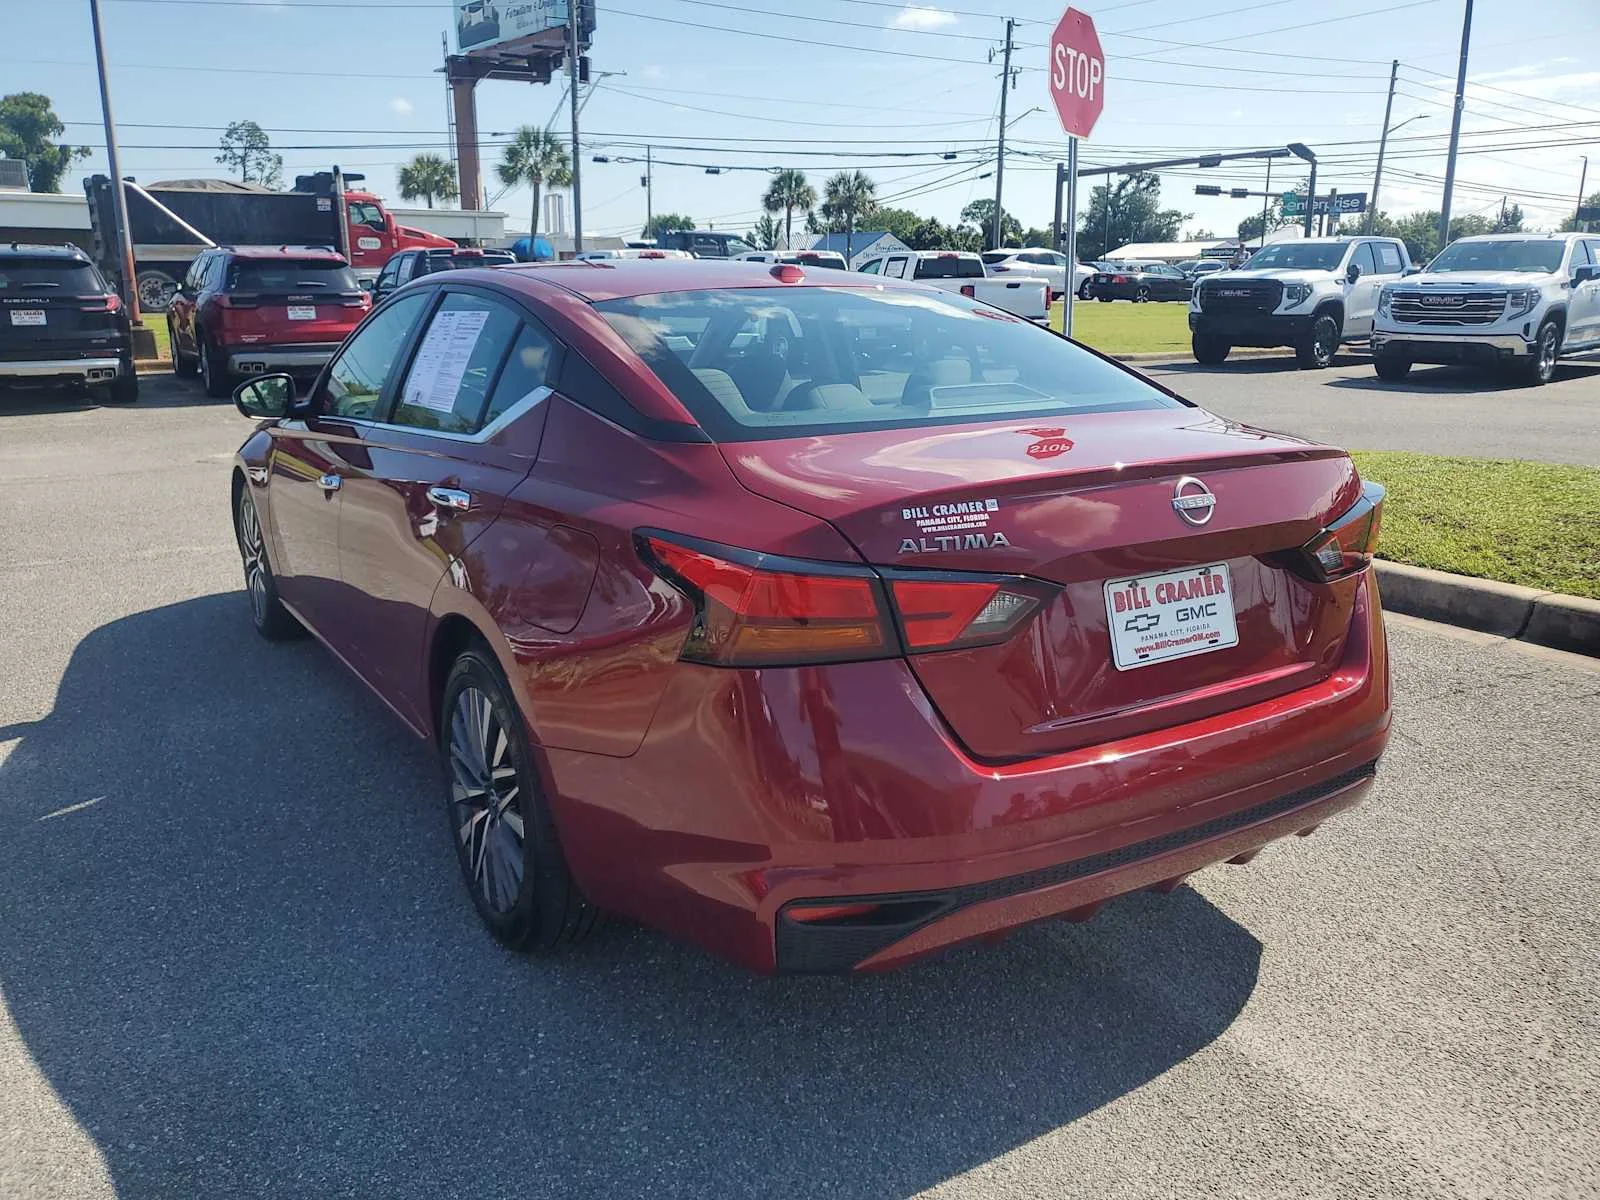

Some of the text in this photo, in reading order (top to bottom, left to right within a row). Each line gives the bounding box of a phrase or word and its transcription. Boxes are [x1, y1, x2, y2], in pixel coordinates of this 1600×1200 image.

[1053, 42, 1102, 102] STOP
[1422, 296, 1464, 304] GMC
[902, 506, 930, 520] BILL
[932, 501, 985, 516] CRAMER
[1174, 495, 1216, 509] NISSAN
[916, 517, 946, 527] PANAMA
[963, 513, 990, 522] FLORIDA
[898, 532, 1011, 554] ALTIMA
[1113, 574, 1225, 613] BILL CRAMER
[1176, 603, 1217, 622] GMC
[1141, 632, 1168, 642] PANAMA
[1186, 623, 1210, 633] FLORIDA
